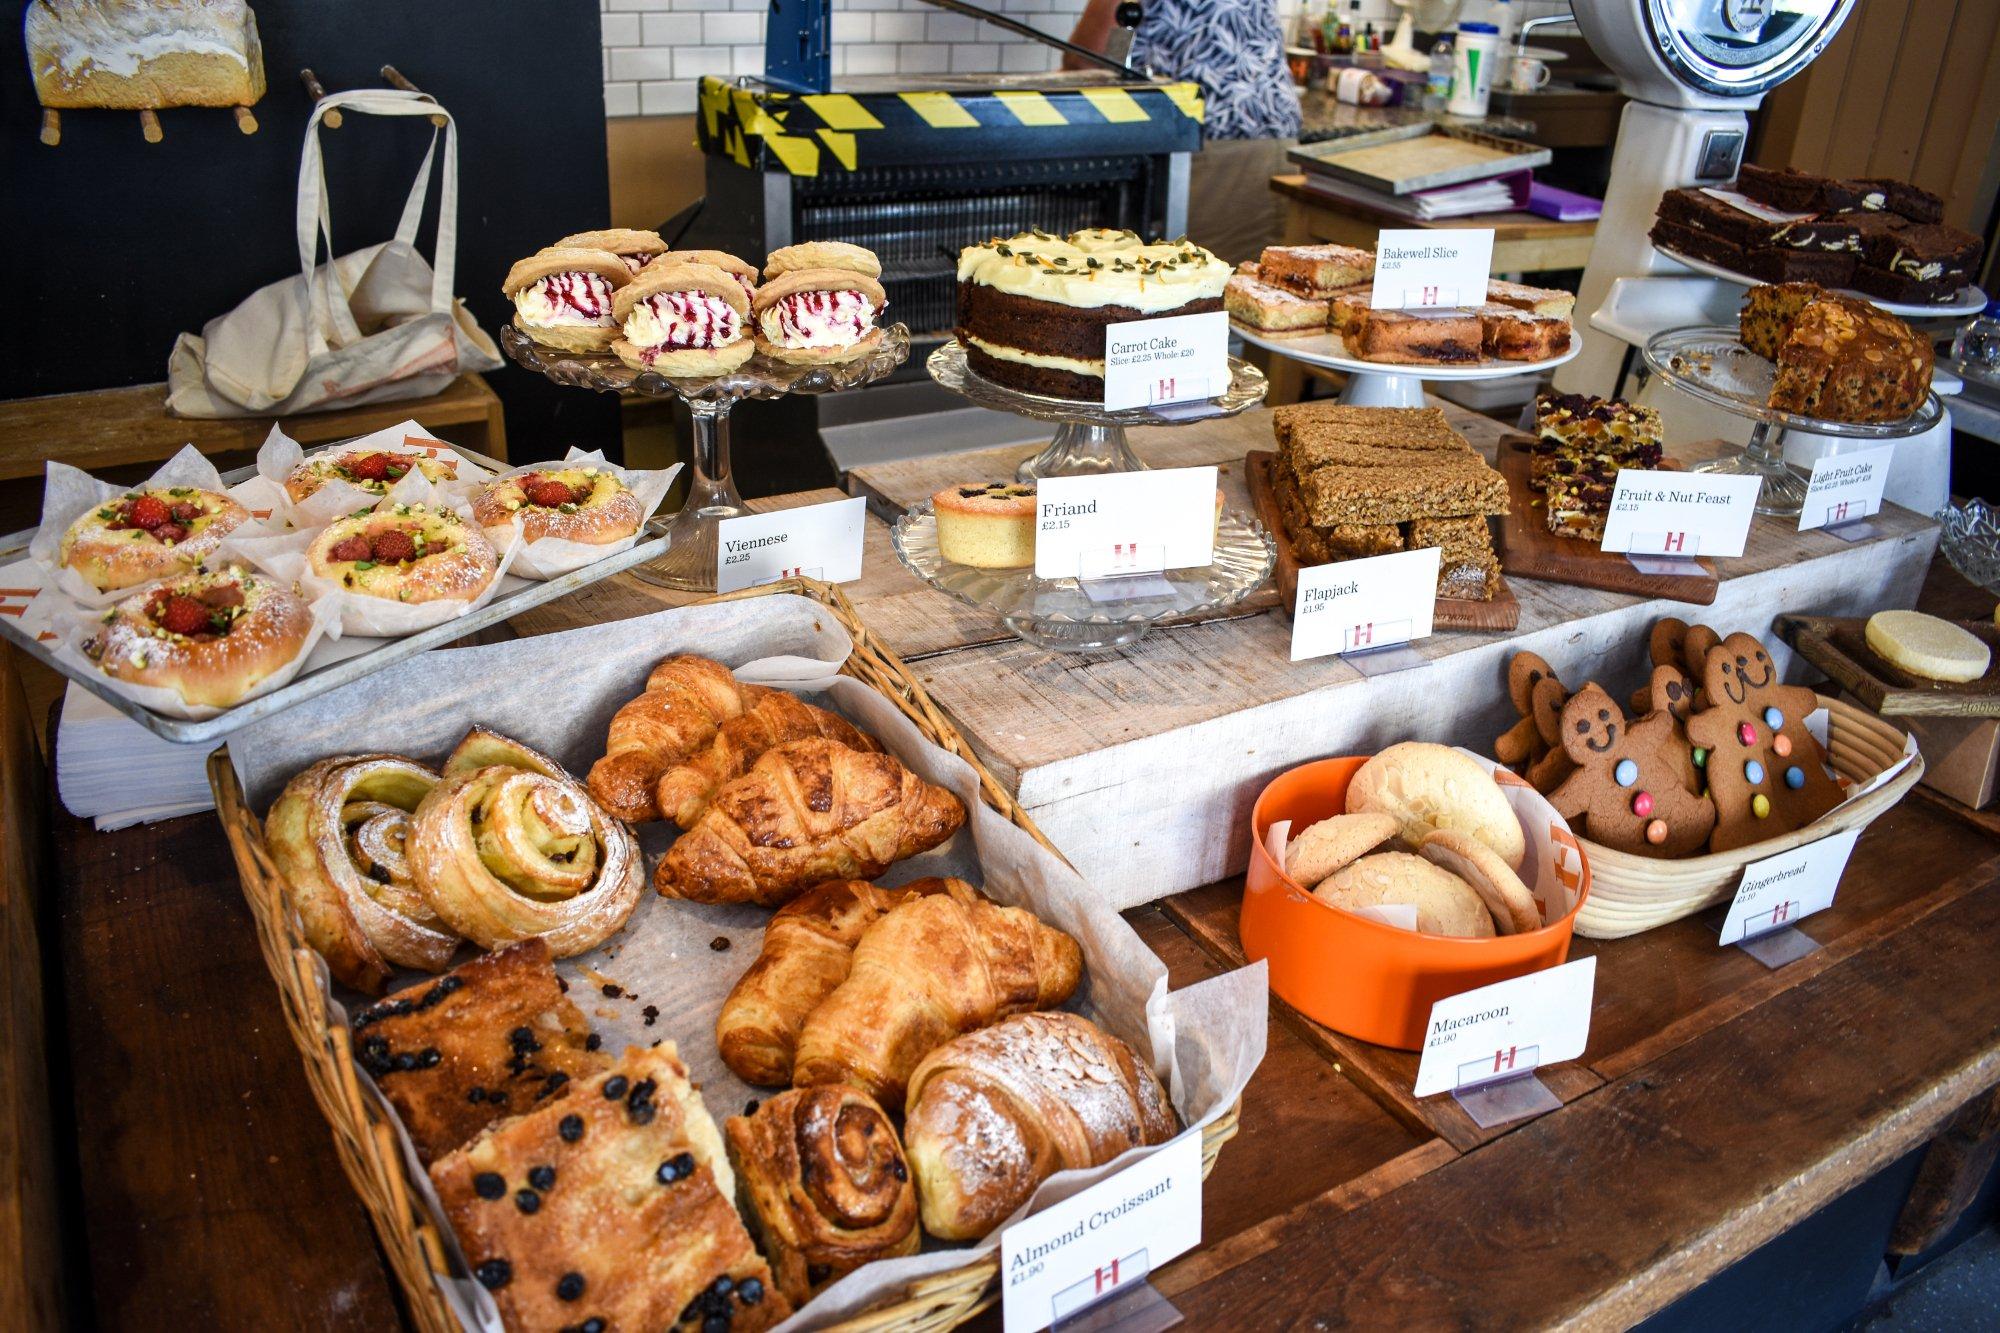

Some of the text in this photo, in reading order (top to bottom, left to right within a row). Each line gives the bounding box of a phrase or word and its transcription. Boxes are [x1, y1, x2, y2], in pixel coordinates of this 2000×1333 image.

[1383, 246, 1458, 259] Bakewell Slice
[1422, 286, 1438, 305] H
[1111, 337, 1177, 355] Carrot Cake
[1110, 349, 1195, 366] Slice: £2.25 Whole: £20
[1159, 378, 1175, 400] H
[1813, 461, 1873, 484] Light Fruit Cake
[1618, 489, 1732, 504] Fruit & Nut Feast
[1042, 500, 1097, 518] Friand
[1615, 504, 1639, 512] £2.15
[1836, 502, 1848, 519] H
[1042, 520, 1070, 531] £2.15
[725, 533, 788, 554] Viennese
[1664, 532, 1685, 551] H
[725, 552, 751, 565] £2.25
[1304, 581, 1359, 603] Flapjack
[1302, 603, 1325, 614] £1.95
[1354, 622, 1373, 646] H
[1741, 861, 1807, 894] Gingerbread
[1736, 891, 1756, 905] £1.10
[1772, 901, 1789, 925] H
[1432, 1005, 1509, 1035] Macaroon
[1428, 1032, 1457, 1048] £1.90
[1493, 1045, 1516, 1073] H
[1010, 1176, 1173, 1272] Almond Croissant
[1010, 1262, 1045, 1287] £1.90
[1095, 1256, 1120, 1295] H
